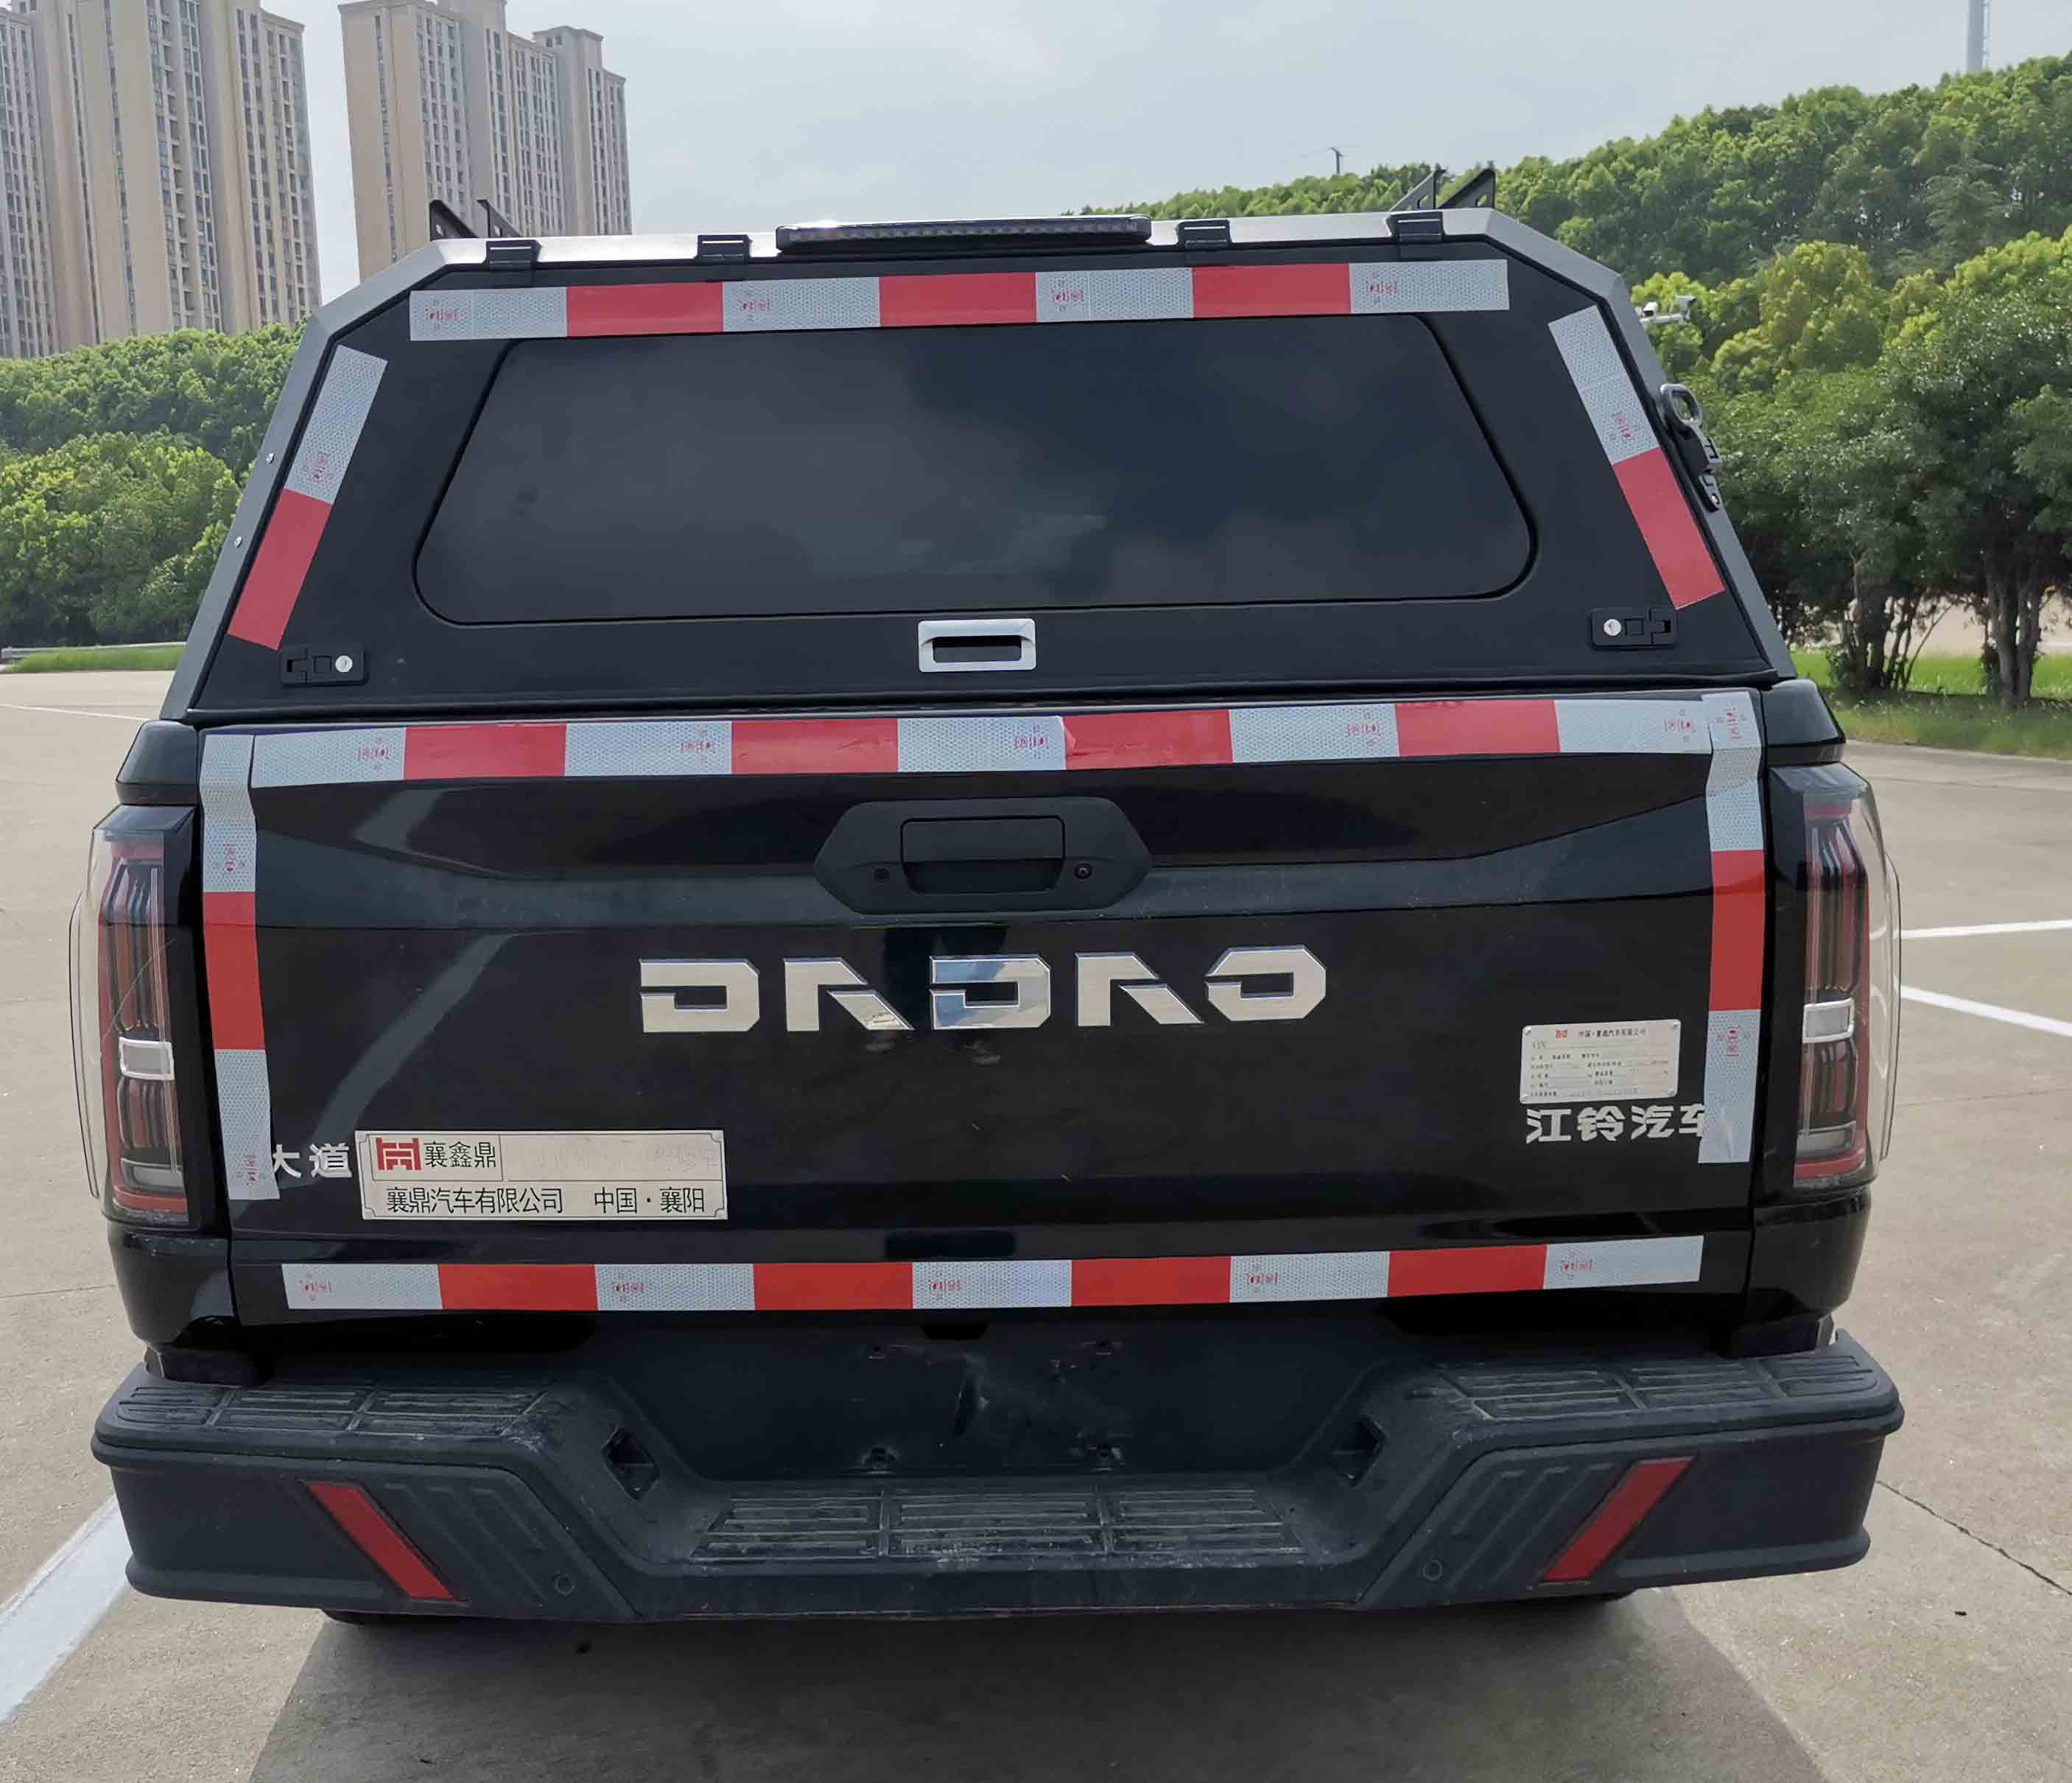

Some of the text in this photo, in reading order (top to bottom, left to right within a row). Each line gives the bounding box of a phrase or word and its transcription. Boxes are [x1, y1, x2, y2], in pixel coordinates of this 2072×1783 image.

[1526, 1104, 1704, 1143] 江铃汽车
[273, 1143, 352, 1178] 大道
[423, 1141, 496, 1168] 襄鑫鼎
[386, 1186, 705, 1214] 襄鼎汽车有限公司 中国·襄阳
